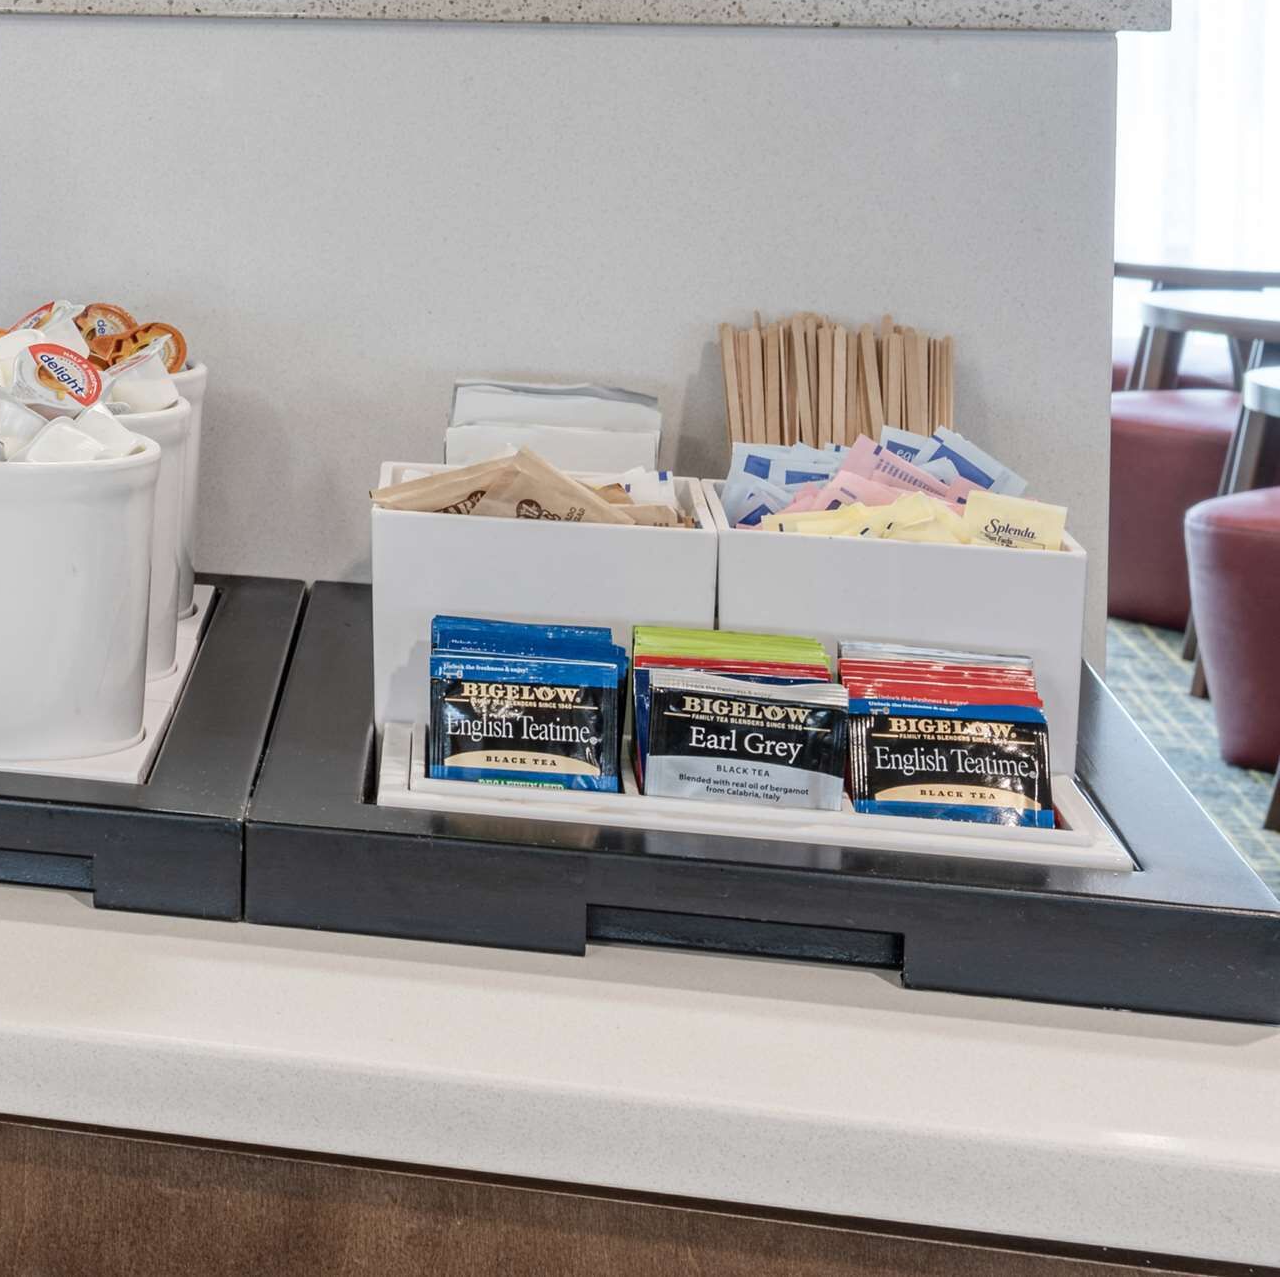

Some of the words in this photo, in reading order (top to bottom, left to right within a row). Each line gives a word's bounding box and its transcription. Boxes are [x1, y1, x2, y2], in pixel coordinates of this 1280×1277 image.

[40, 354, 85, 395] delight
[984, 518, 1036, 539] Splenda
[461, 681, 580, 703] BIGELOW
[682, 696, 812, 724] BIGELOW
[691, 713, 715, 722] FAMILY
[716, 715, 729, 723] TEA
[730, 717, 764, 727] BLENDERS
[766, 721, 786, 729] SINCE
[447, 713, 514, 743] English
[516, 715, 591, 744] Teatime
[888, 717, 1015, 739] BIGELOW
[689, 725, 737, 752] Earl
[743, 732, 804, 764] Grey
[485, 755, 527, 765] BLACK
[532, 758, 558, 767] TEA
[716, 764, 749, 775] BLACK
[752, 768, 771, 777] TEA
[873, 746, 948, 776] English
[950, 749, 1029, 778] Teatime
[679, 773, 712, 785] Blended
[712, 778, 728, 788] with
[729, 780, 747, 789] real
[747, 781, 759, 790] oil
[759, 783, 770, 791] of
[769, 783, 810, 796] bergamot
[705, 785, 726, 795] from
[762, 791, 781, 802] Italy
[920, 789, 964, 799] BLACK
[969, 791, 997, 800] TEA
